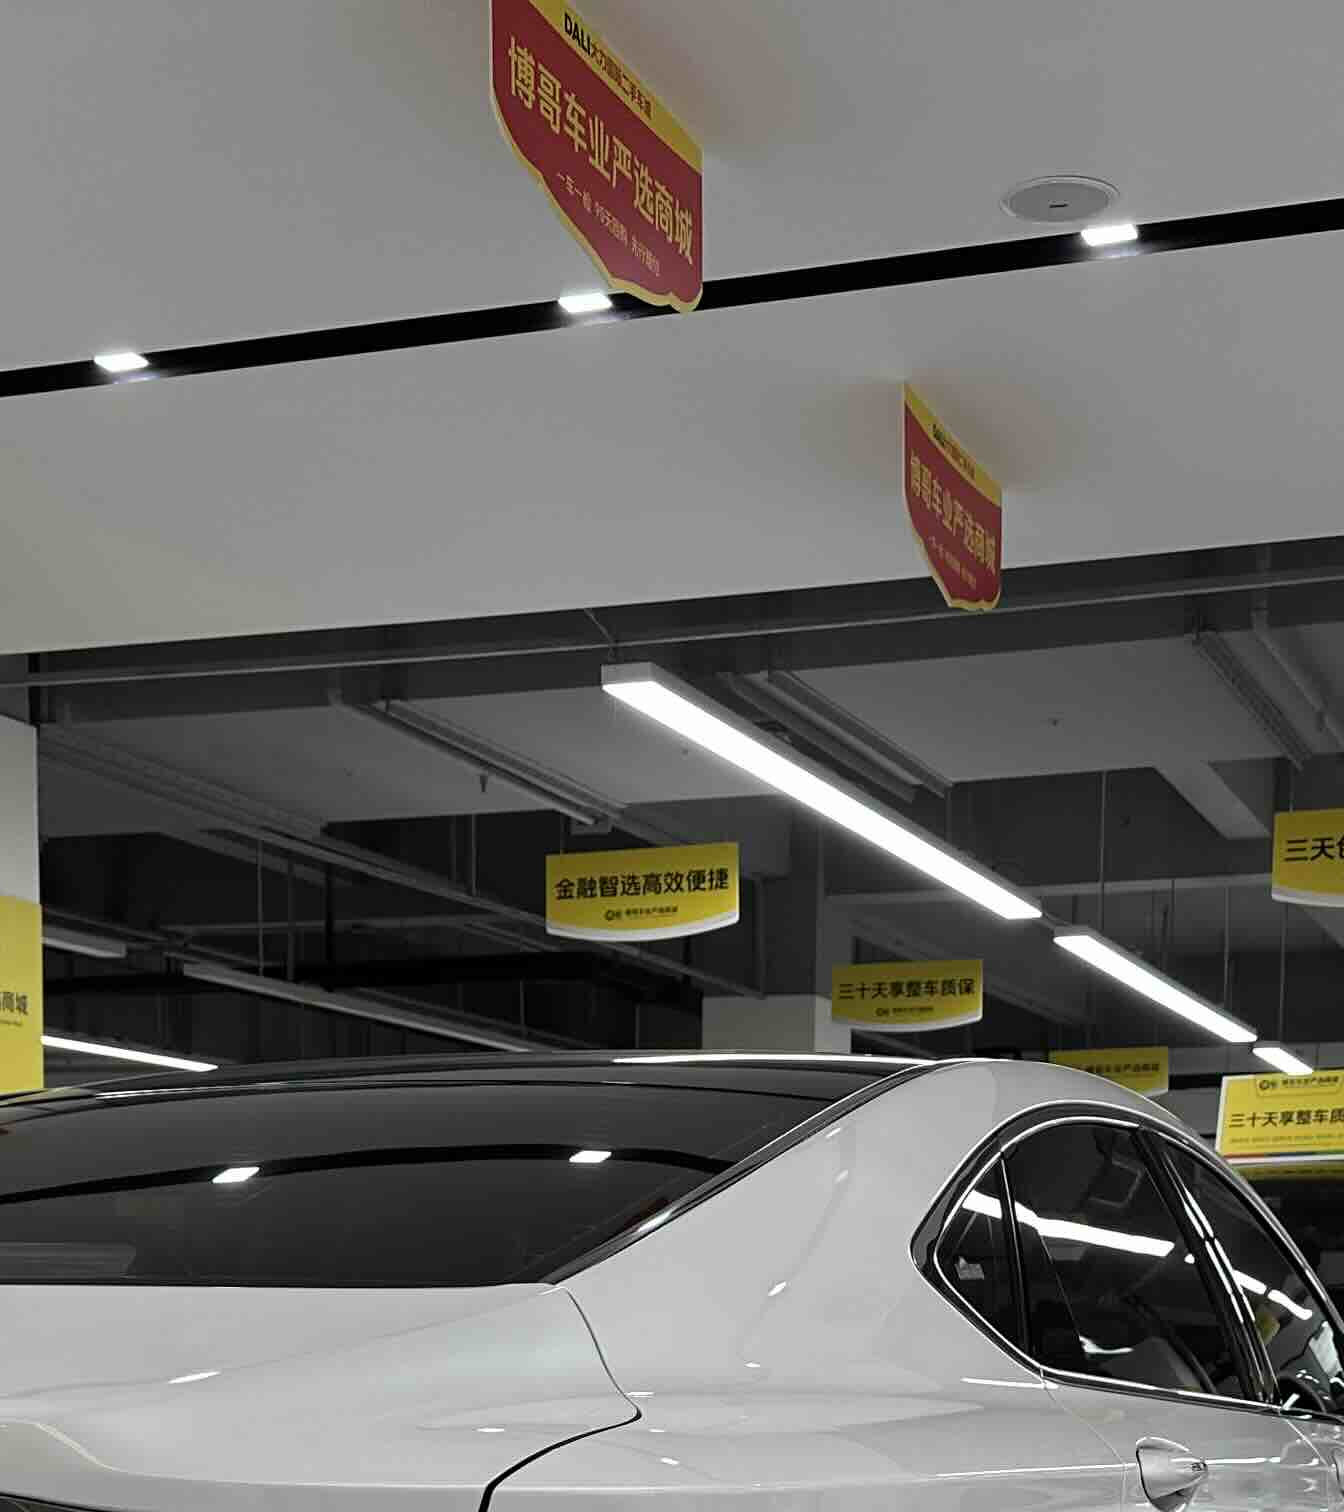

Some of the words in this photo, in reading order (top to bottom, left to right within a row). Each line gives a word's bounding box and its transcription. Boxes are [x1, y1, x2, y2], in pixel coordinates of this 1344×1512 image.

[508, 36, 693, 265] 博哥车业严选商城
[555, 867, 729, 900] 金融智选高效便捷
